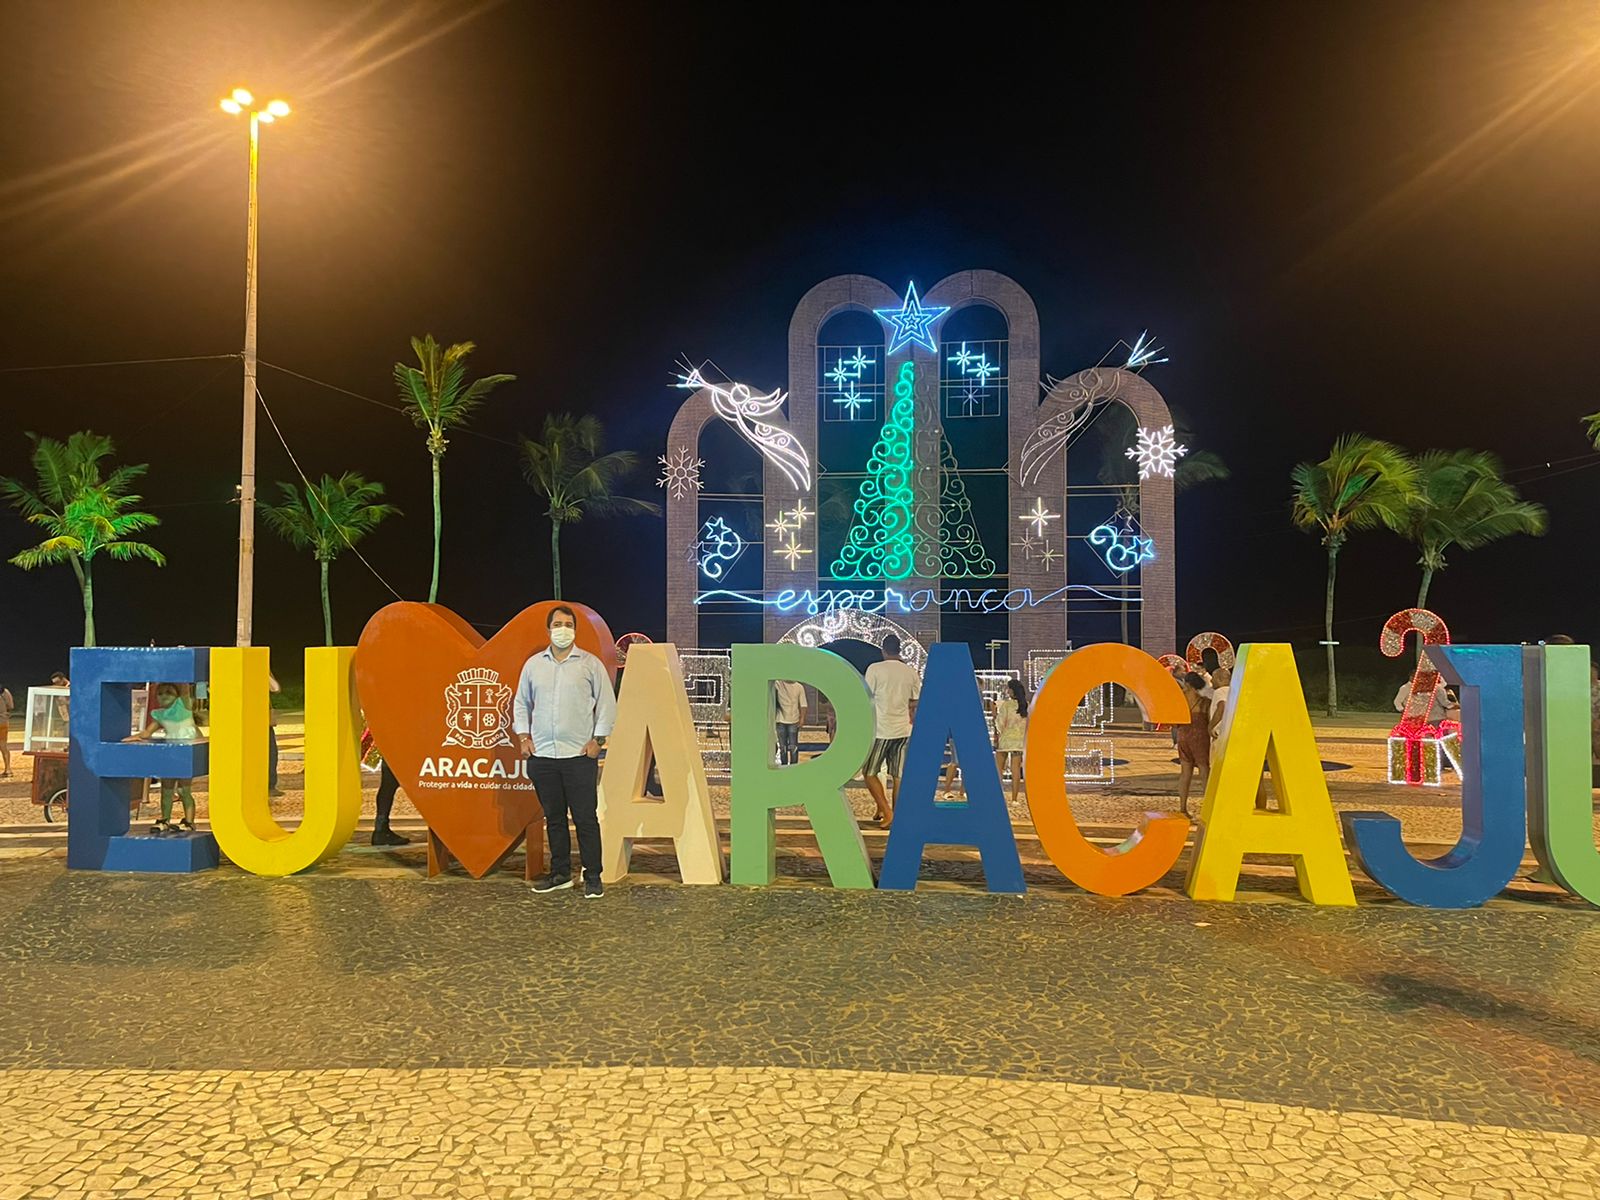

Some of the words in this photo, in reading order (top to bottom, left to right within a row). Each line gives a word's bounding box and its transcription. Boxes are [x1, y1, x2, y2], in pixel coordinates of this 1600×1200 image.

[772, 586, 1040, 615] esperança
[68, 645, 361, 877] EU
[418, 780, 450, 789] Proteger
[457, 781, 472, 789] vida
[480, 781, 501, 790] cuidar
[502, 782, 512, 790] da
